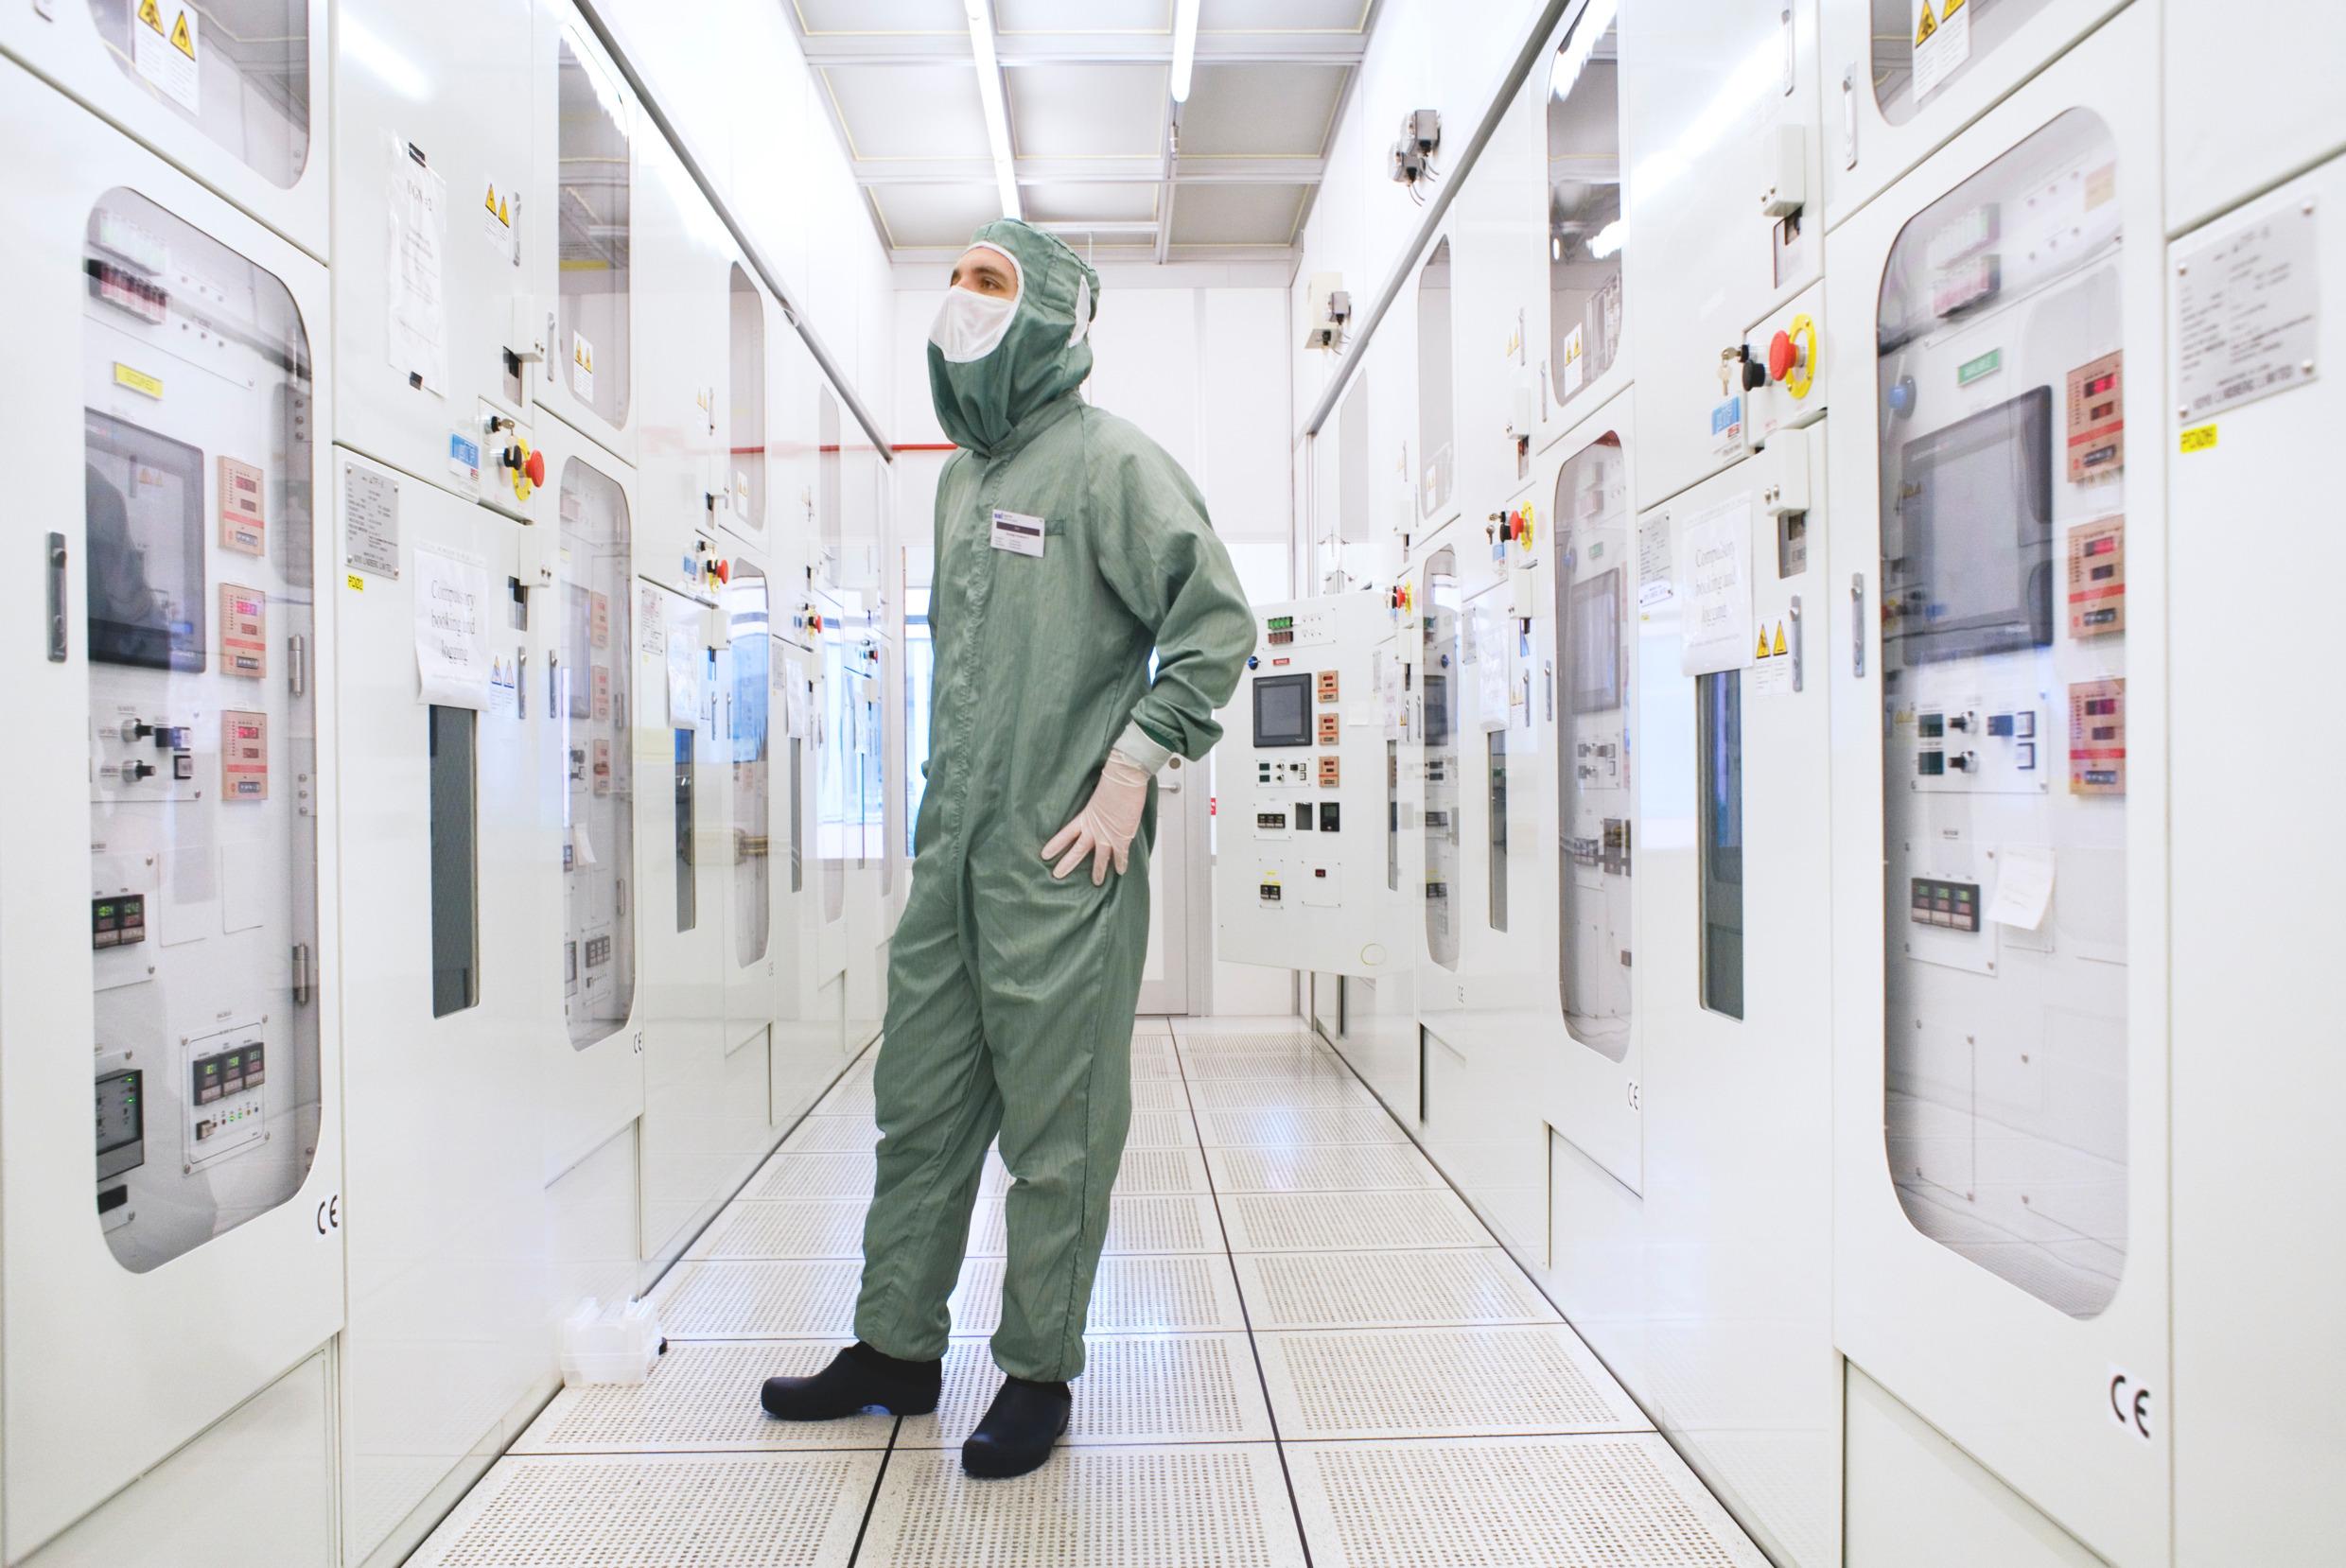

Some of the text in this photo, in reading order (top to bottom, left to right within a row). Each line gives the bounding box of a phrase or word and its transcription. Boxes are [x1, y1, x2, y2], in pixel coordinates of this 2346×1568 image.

[431, 579, 476, 611] Compulsory
[431, 609, 476, 637] booking and
[441, 638, 469, 667] logging
[634, 1032, 642, 1054] CE
[1628, 1082, 1638, 1110] CE
[317, 1194, 339, 1235] CE
[2110, 1374, 2150, 1438] CE
